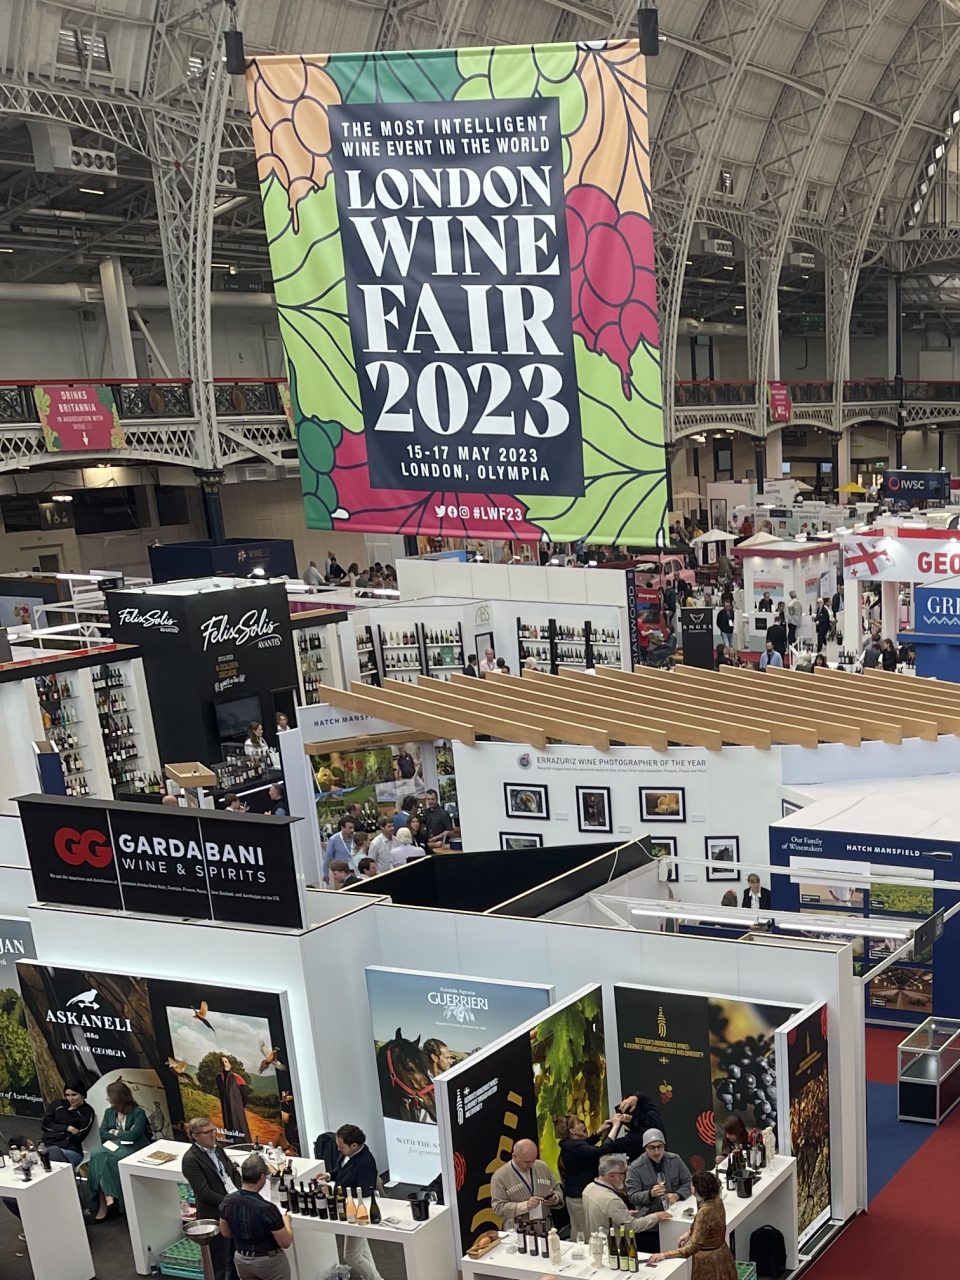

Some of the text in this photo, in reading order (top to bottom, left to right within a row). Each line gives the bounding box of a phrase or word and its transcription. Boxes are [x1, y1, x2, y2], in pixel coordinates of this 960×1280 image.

[341, 116, 548, 137] THE MOST INTELLIGENT
[341, 136, 550, 157] WINE EVENT IN THE WORLD
[344, 165, 552, 210] LONDON
[348, 214, 560, 278] WINE
[357, 282, 564, 356] FAIR
[61, 391, 88, 400] DRINKS
[365, 361, 570, 438] 2023
[58, 403, 97, 412] BRITANNIA
[406, 444, 538, 463] 15-17 MAY 2023
[400, 462, 550, 482] LONDON, OLYMPIA
[900, 479, 925, 490] IWSC
[473, 506, 523, 521] #LWF23
[314, 714, 374, 727] HATCH MANS
[537, 756, 707, 767] ERRAZURIZ WINE PHOTOGRAPHER OF THE YEAR
[54, 827, 264, 868] GG GARDABANI
[782, 842, 823, 852] of Winemakers
[790, 836, 823, 847] Our Family
[846, 844, 921, 857] HATCH MANSFIELD
[121, 858, 267, 883] WINE & SPIRITS
[427, 992, 489, 1010] GUERRIERI
[46, 1009, 133, 1032] ASKANELI
[80, 1044, 91, 1053] OF
[92, 1046, 127, 1058] GEORGIA
[396, 1137, 431, 1148] WITH THE
